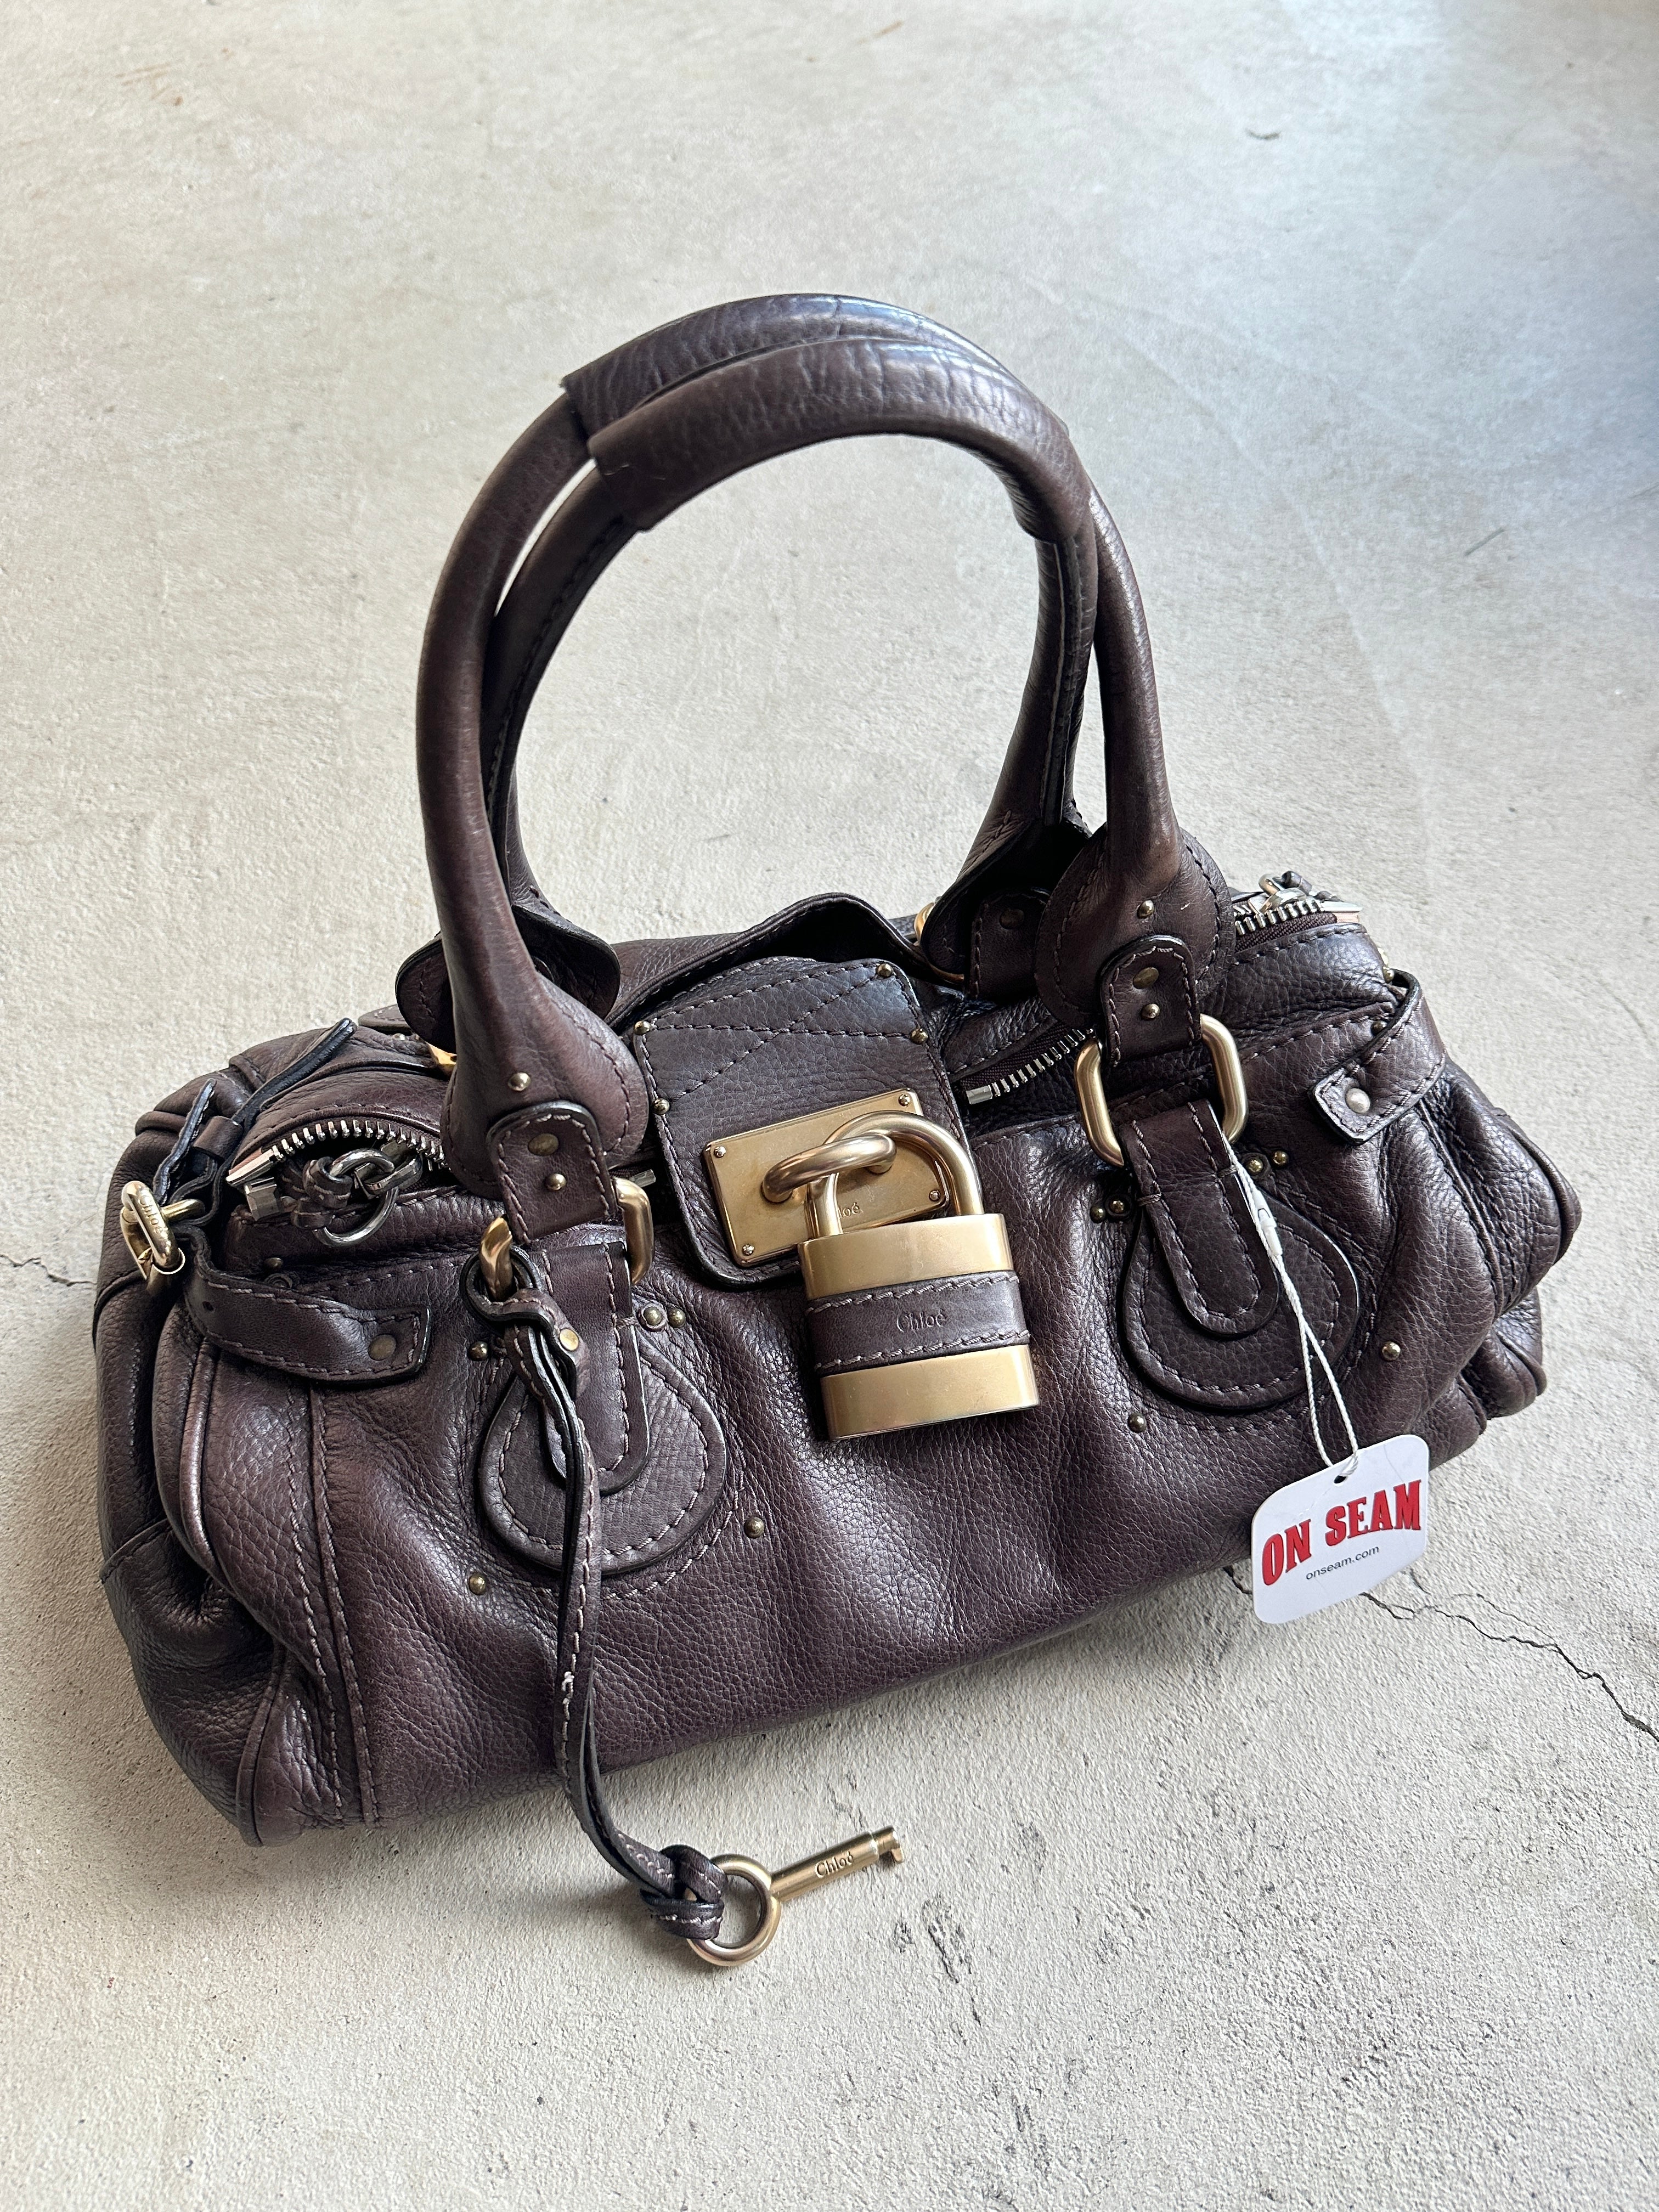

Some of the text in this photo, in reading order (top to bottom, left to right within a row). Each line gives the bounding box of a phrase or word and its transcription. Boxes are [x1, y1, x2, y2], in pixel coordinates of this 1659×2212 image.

[838, 1201, 861, 1218] loé
[896, 1308, 947, 1333] Chloé
[1262, 1479, 1422, 1585] ON SEAM
[1306, 1546, 1379, 1580] onseam.com
[814, 1850, 854, 1878] Chloé
